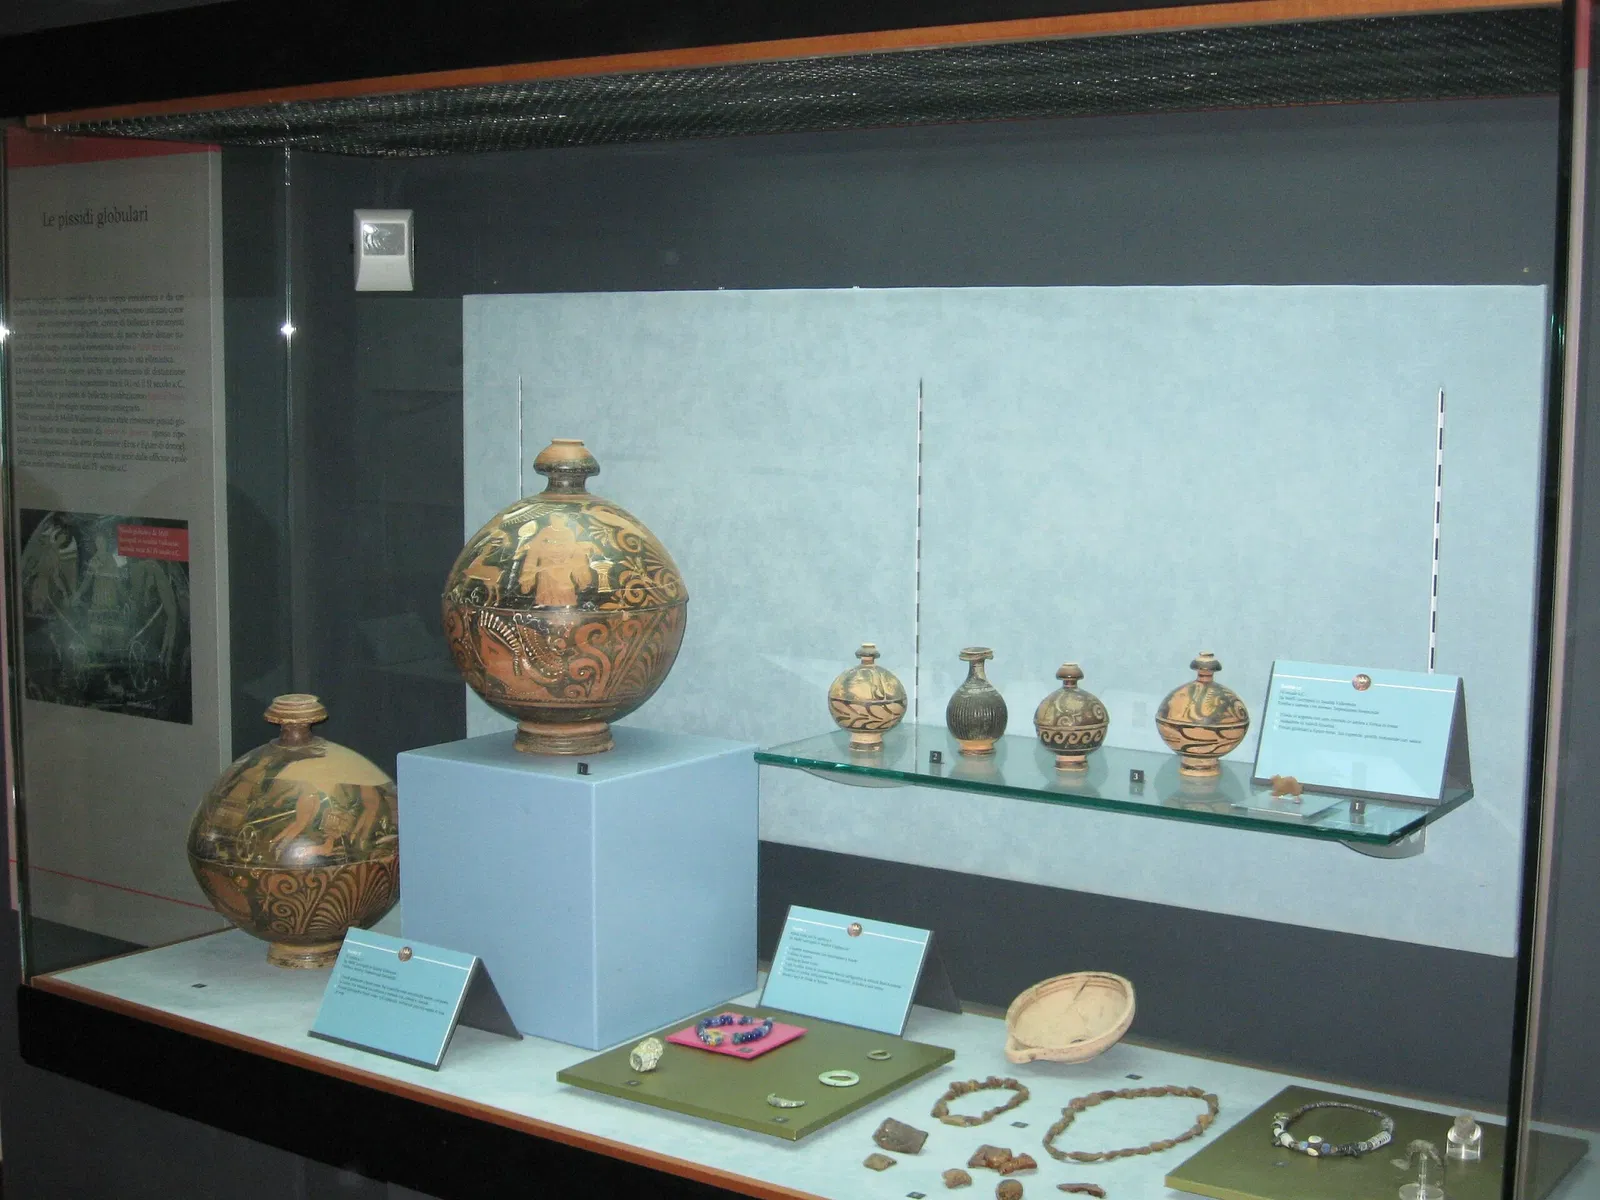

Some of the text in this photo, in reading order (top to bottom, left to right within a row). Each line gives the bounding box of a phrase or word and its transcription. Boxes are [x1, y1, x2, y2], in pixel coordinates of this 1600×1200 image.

[43, 204, 148, 231] Le pissidi globulari
[1133, 772, 1139, 780] 3
